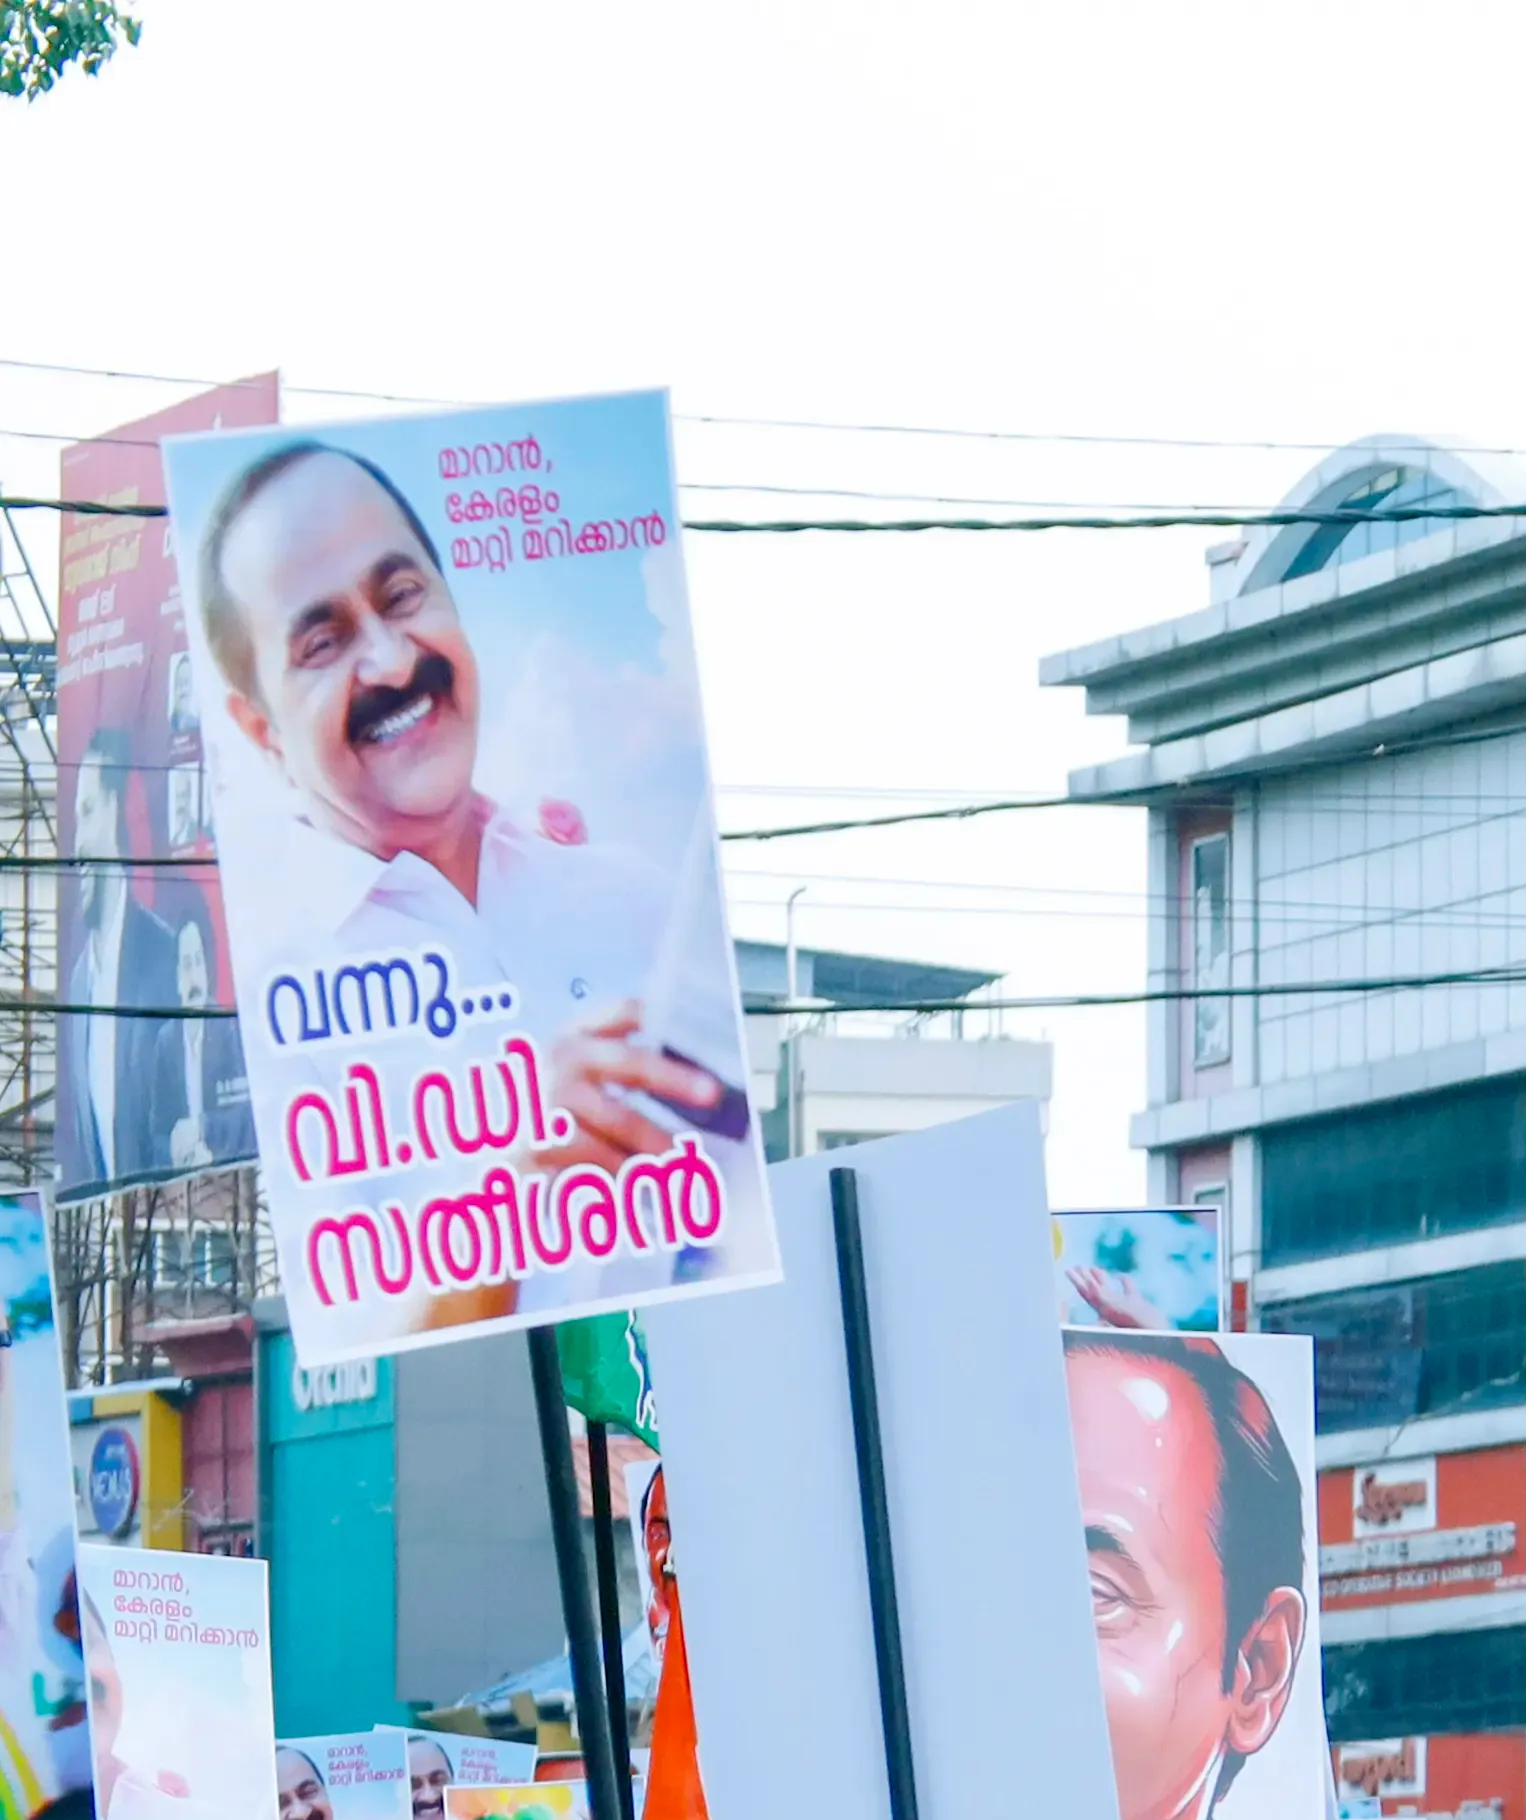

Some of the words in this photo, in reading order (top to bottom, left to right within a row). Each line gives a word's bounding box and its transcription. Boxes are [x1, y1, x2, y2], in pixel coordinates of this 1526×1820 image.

[438, 434, 555, 481] മാറാൻ,
[444, 490, 561, 527] കേരളം
[450, 526, 514, 575] മാറ്റി
[521, 509, 668, 565] മറിക്കാൻ
[265, 950, 514, 1046] വന്നു...
[284, 1039, 572, 1183] വി.ഡി.
[305, 1137, 723, 1307] സതീശൻ
[113, 1569, 190, 1595] മാറാൻ,
[113, 1595, 193, 1622] കേരളം
[114, 1618, 158, 1644] മാറ്റി
[164, 1622, 260, 1649] മറിക്കാൻ
